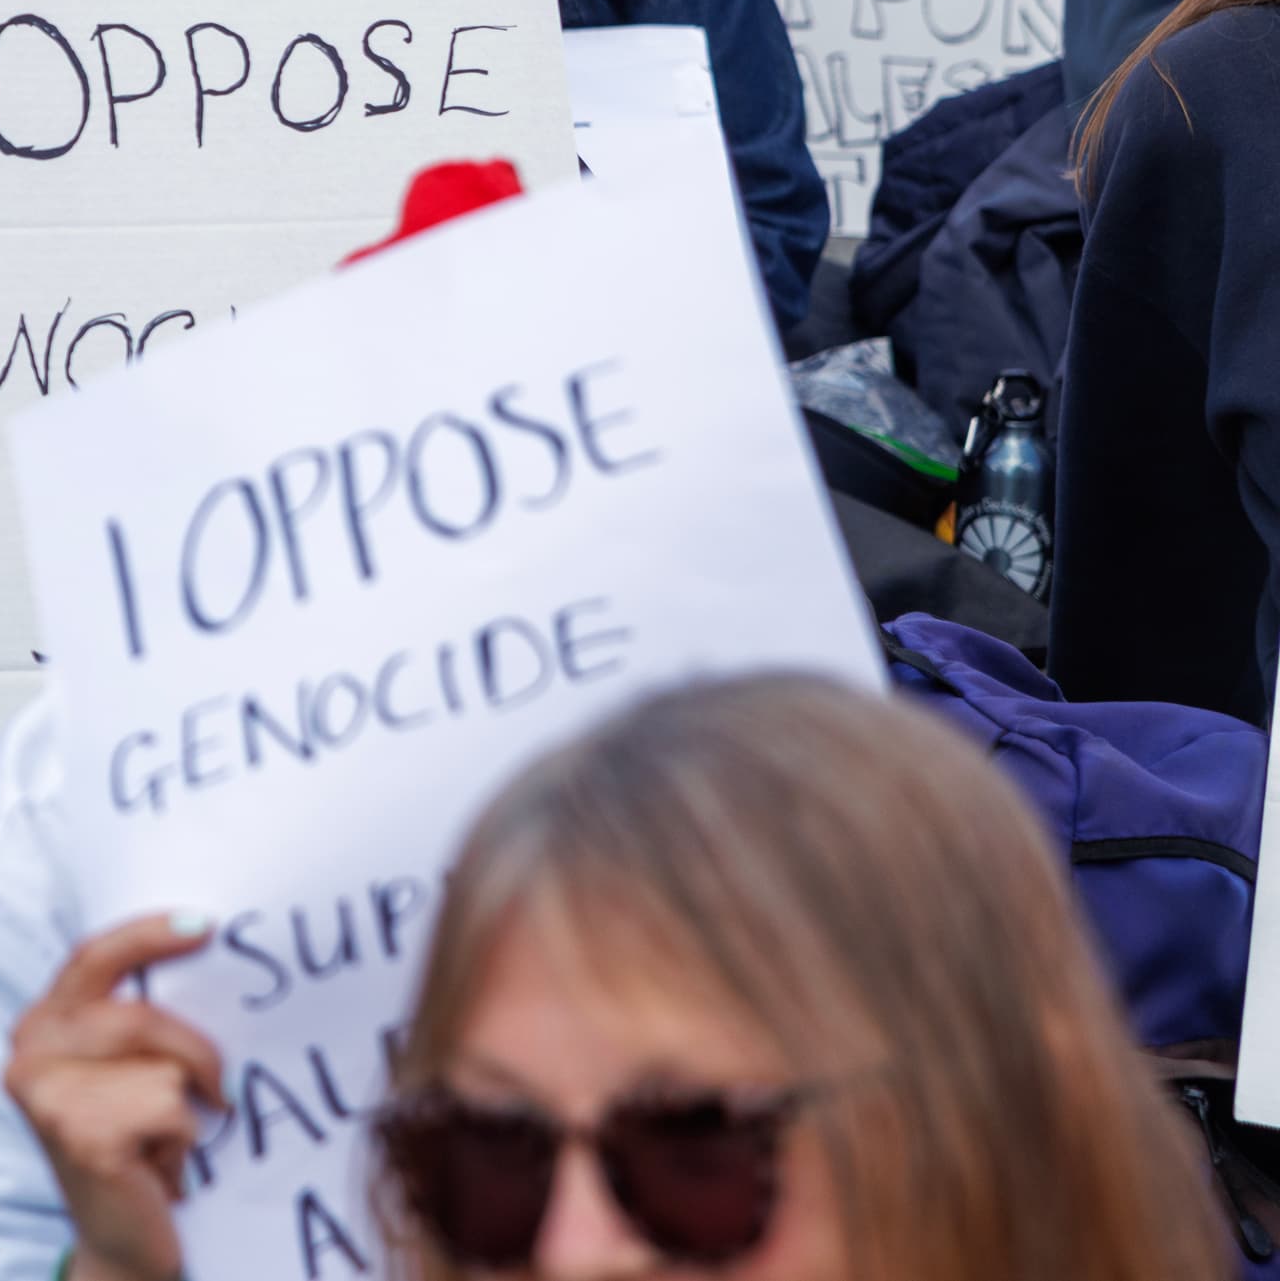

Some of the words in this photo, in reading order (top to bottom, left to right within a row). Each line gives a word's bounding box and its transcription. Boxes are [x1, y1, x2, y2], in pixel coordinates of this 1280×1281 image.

[105, 515, 146, 663] I
[179, 354, 668, 640] OPPOSE
[104, 594, 635, 822] GENOCIDE
